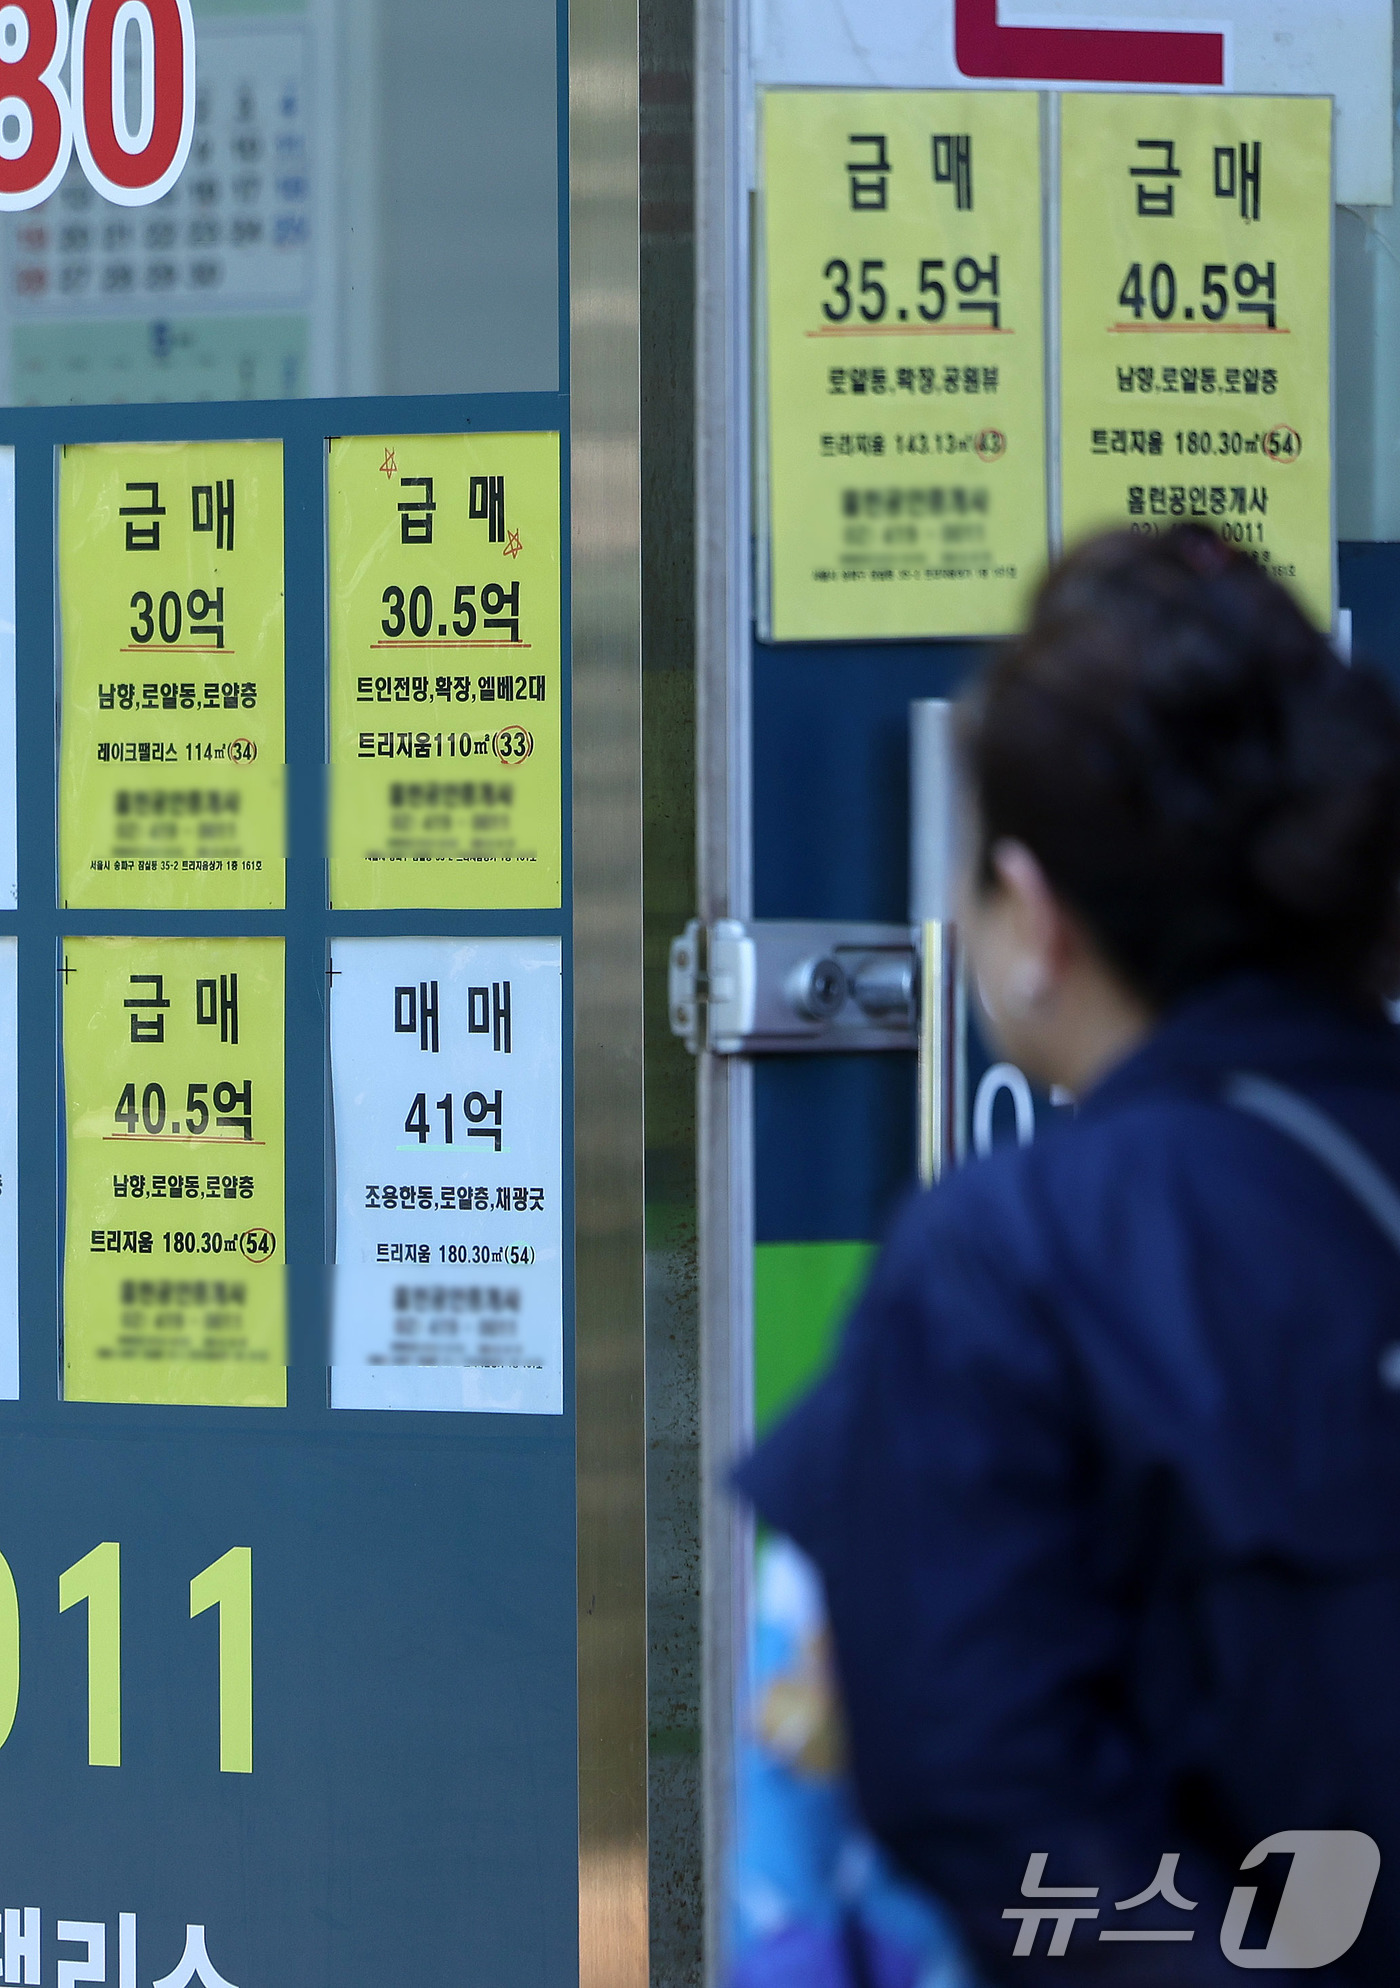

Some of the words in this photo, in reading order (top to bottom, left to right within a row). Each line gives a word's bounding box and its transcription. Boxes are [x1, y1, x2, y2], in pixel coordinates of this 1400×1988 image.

[822, 255, 1000, 330] 35.5억
[1118, 262, 1277, 330] 40.5억
[129, 587, 225, 649] 30억
[381, 581, 520, 642] 30.5억
[98, 683, 257, 710] 남향,로얄동,로얄층
[357, 675, 546, 702] 트인전망,확장,엘베2대
[97, 742, 178, 762] 레이크팰리스
[161, 861, 179, 871] 35-2
[242, 860, 262, 871] 161호
[114, 1080, 253, 1141] 40.5억
[404, 1089, 503, 1152] 41억
[113, 1175, 254, 1200] 남향,로얄동,로얄층
[365, 1185, 545, 1212] 조용한동,로얄층,채광굿
[90, 1230, 153, 1253] 트리지움
[376, 1243, 431, 1263] 트리지움
[0, 1541, 253, 1774] 11
